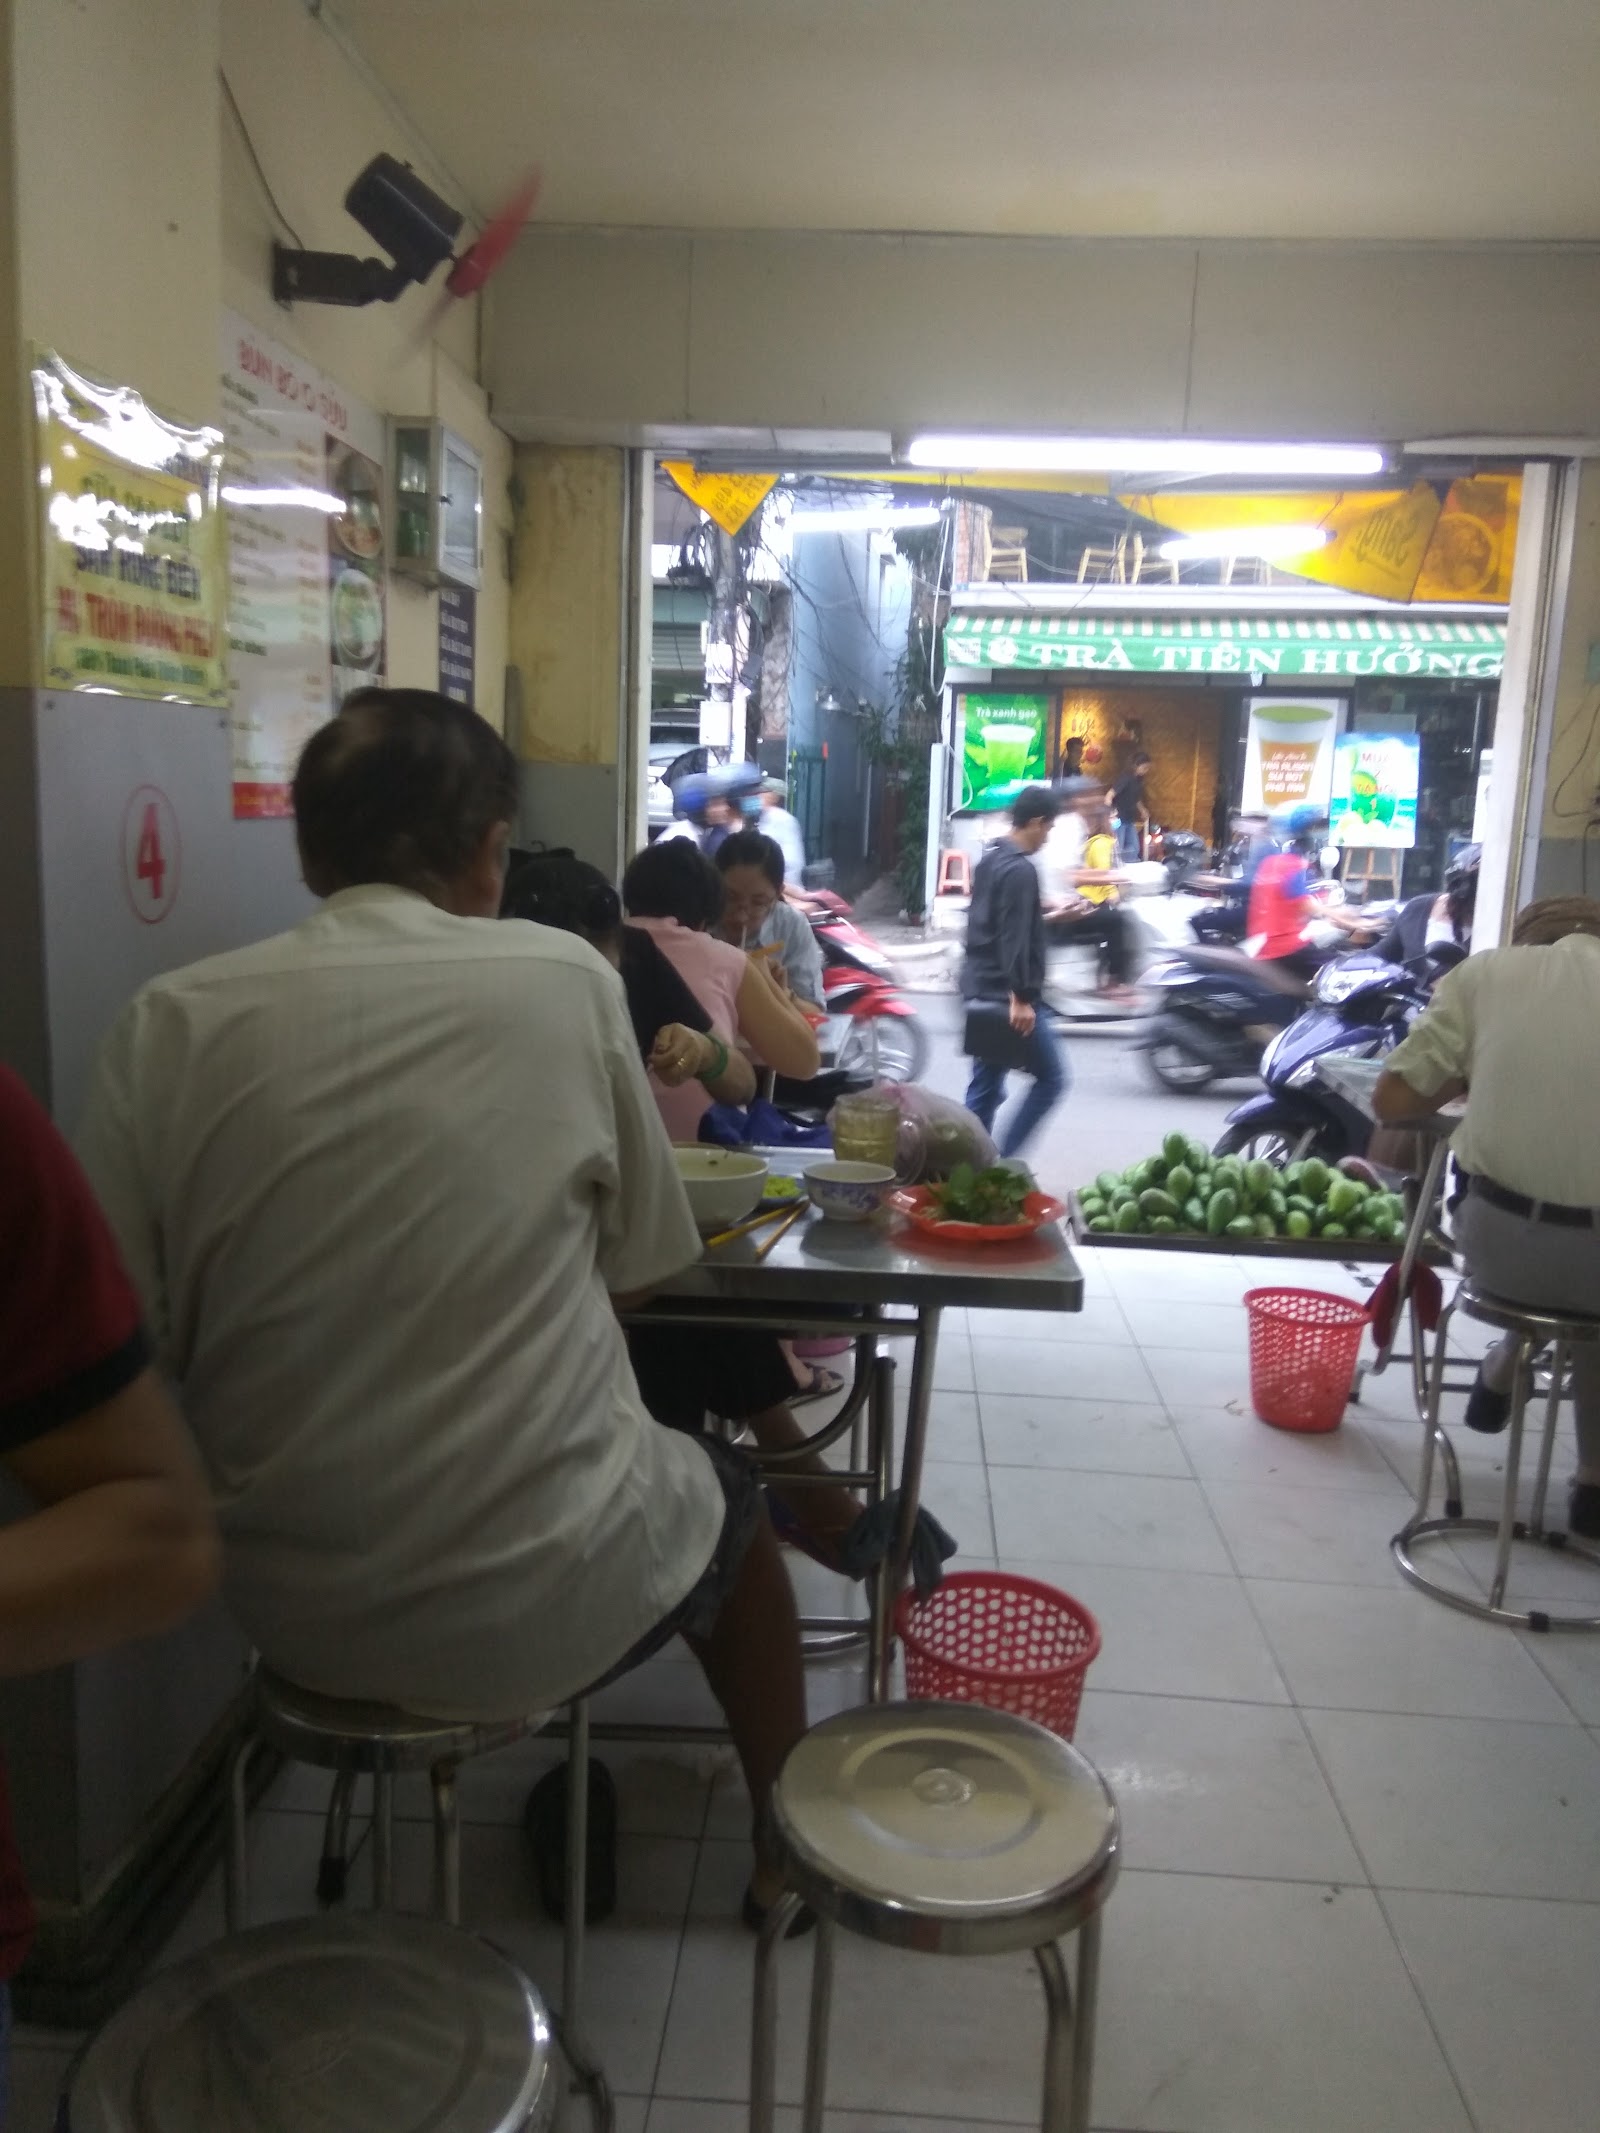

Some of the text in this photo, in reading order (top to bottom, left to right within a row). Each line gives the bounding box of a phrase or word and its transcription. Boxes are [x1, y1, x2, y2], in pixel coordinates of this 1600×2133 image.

[1030, 638, 1134, 669] TRÀ
[1153, 641, 1284, 673] TIÊN
[976, 706, 991, 718] Trà
[992, 707, 1017, 718] xanh
[1362, 752, 1391, 763] MUA
[137, 802, 166, 899] 4
